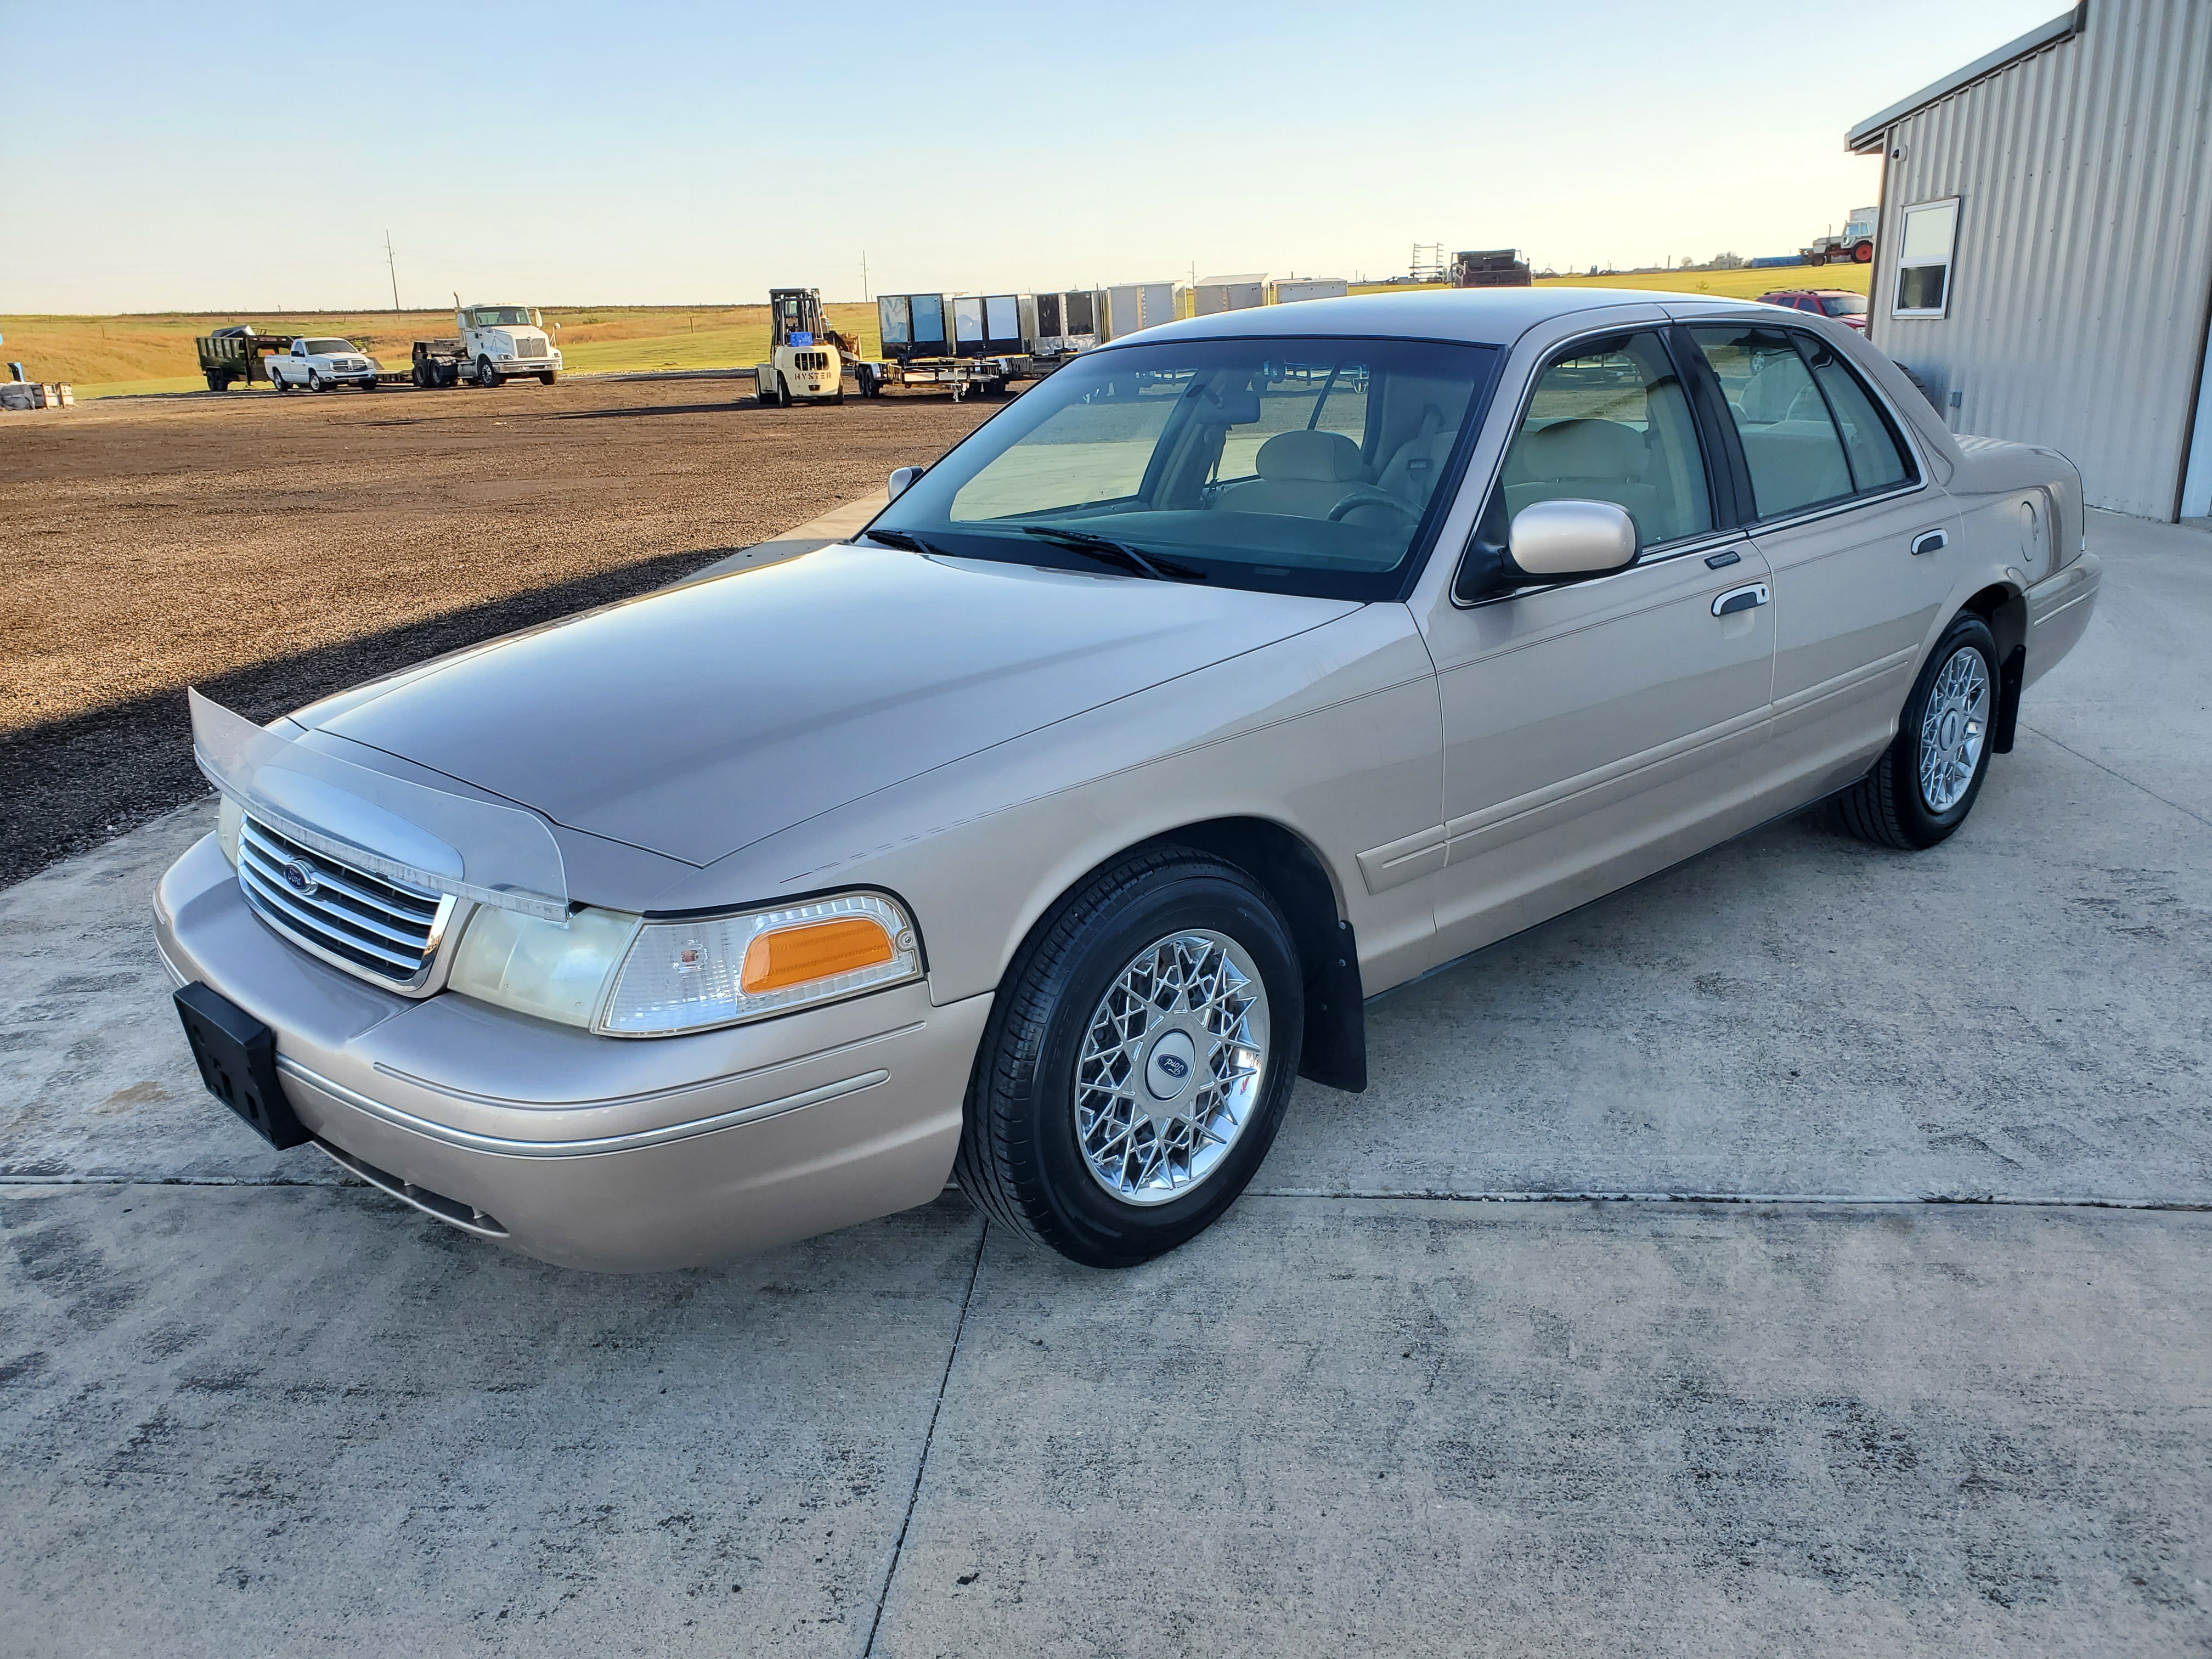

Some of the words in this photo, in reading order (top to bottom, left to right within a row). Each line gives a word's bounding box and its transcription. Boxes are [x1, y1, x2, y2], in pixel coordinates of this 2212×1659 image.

[794, 371, 832, 380] HYSTER
[287, 867, 302, 885] Ford
[1164, 1058, 1184, 1075] Ford
